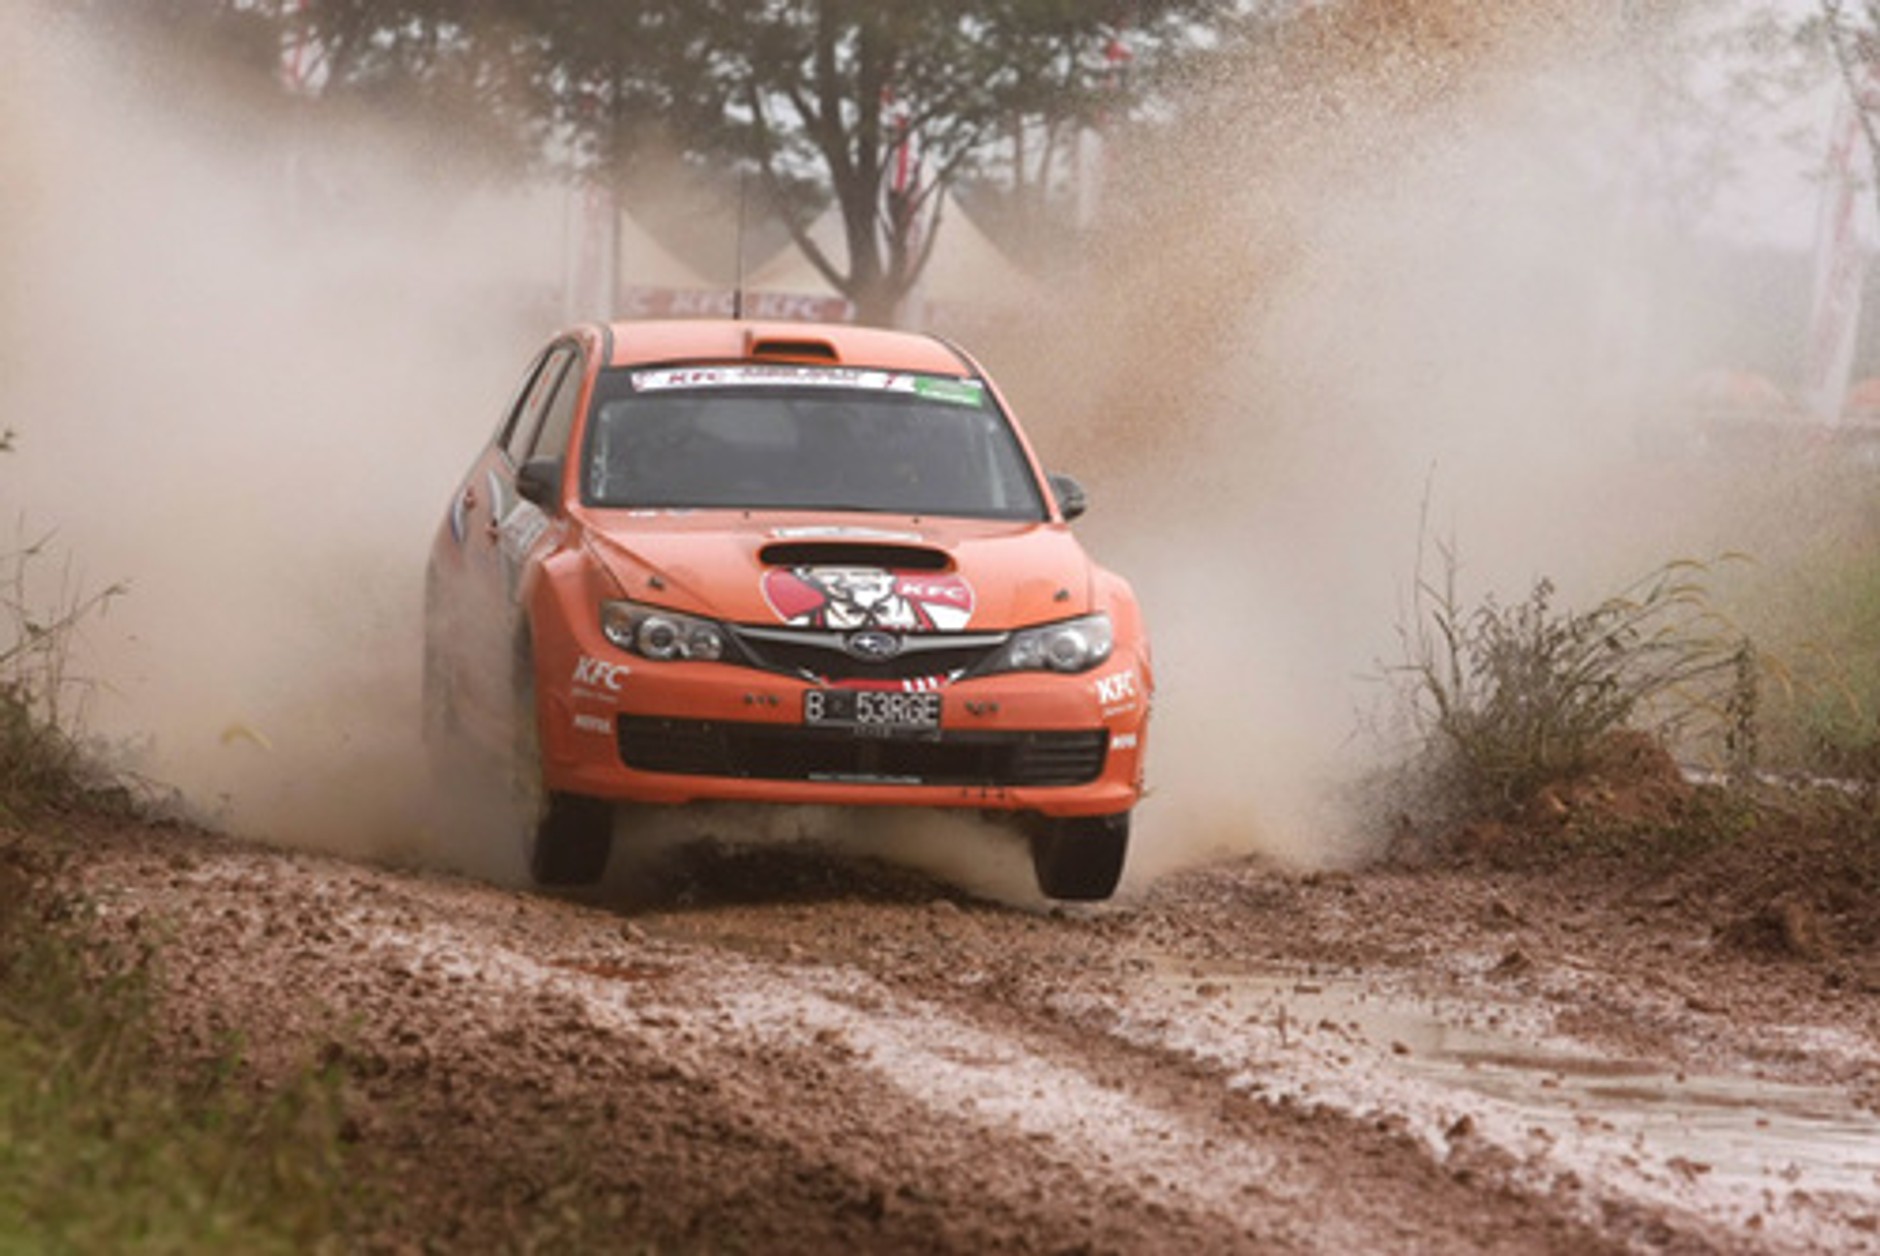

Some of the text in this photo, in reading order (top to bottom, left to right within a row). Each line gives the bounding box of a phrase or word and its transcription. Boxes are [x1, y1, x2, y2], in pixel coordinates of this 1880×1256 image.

[902, 583, 963, 600] KFC
[572, 656, 632, 692] KFC
[1096, 671, 1135, 705] KFC
[806, 691, 825, 721] B
